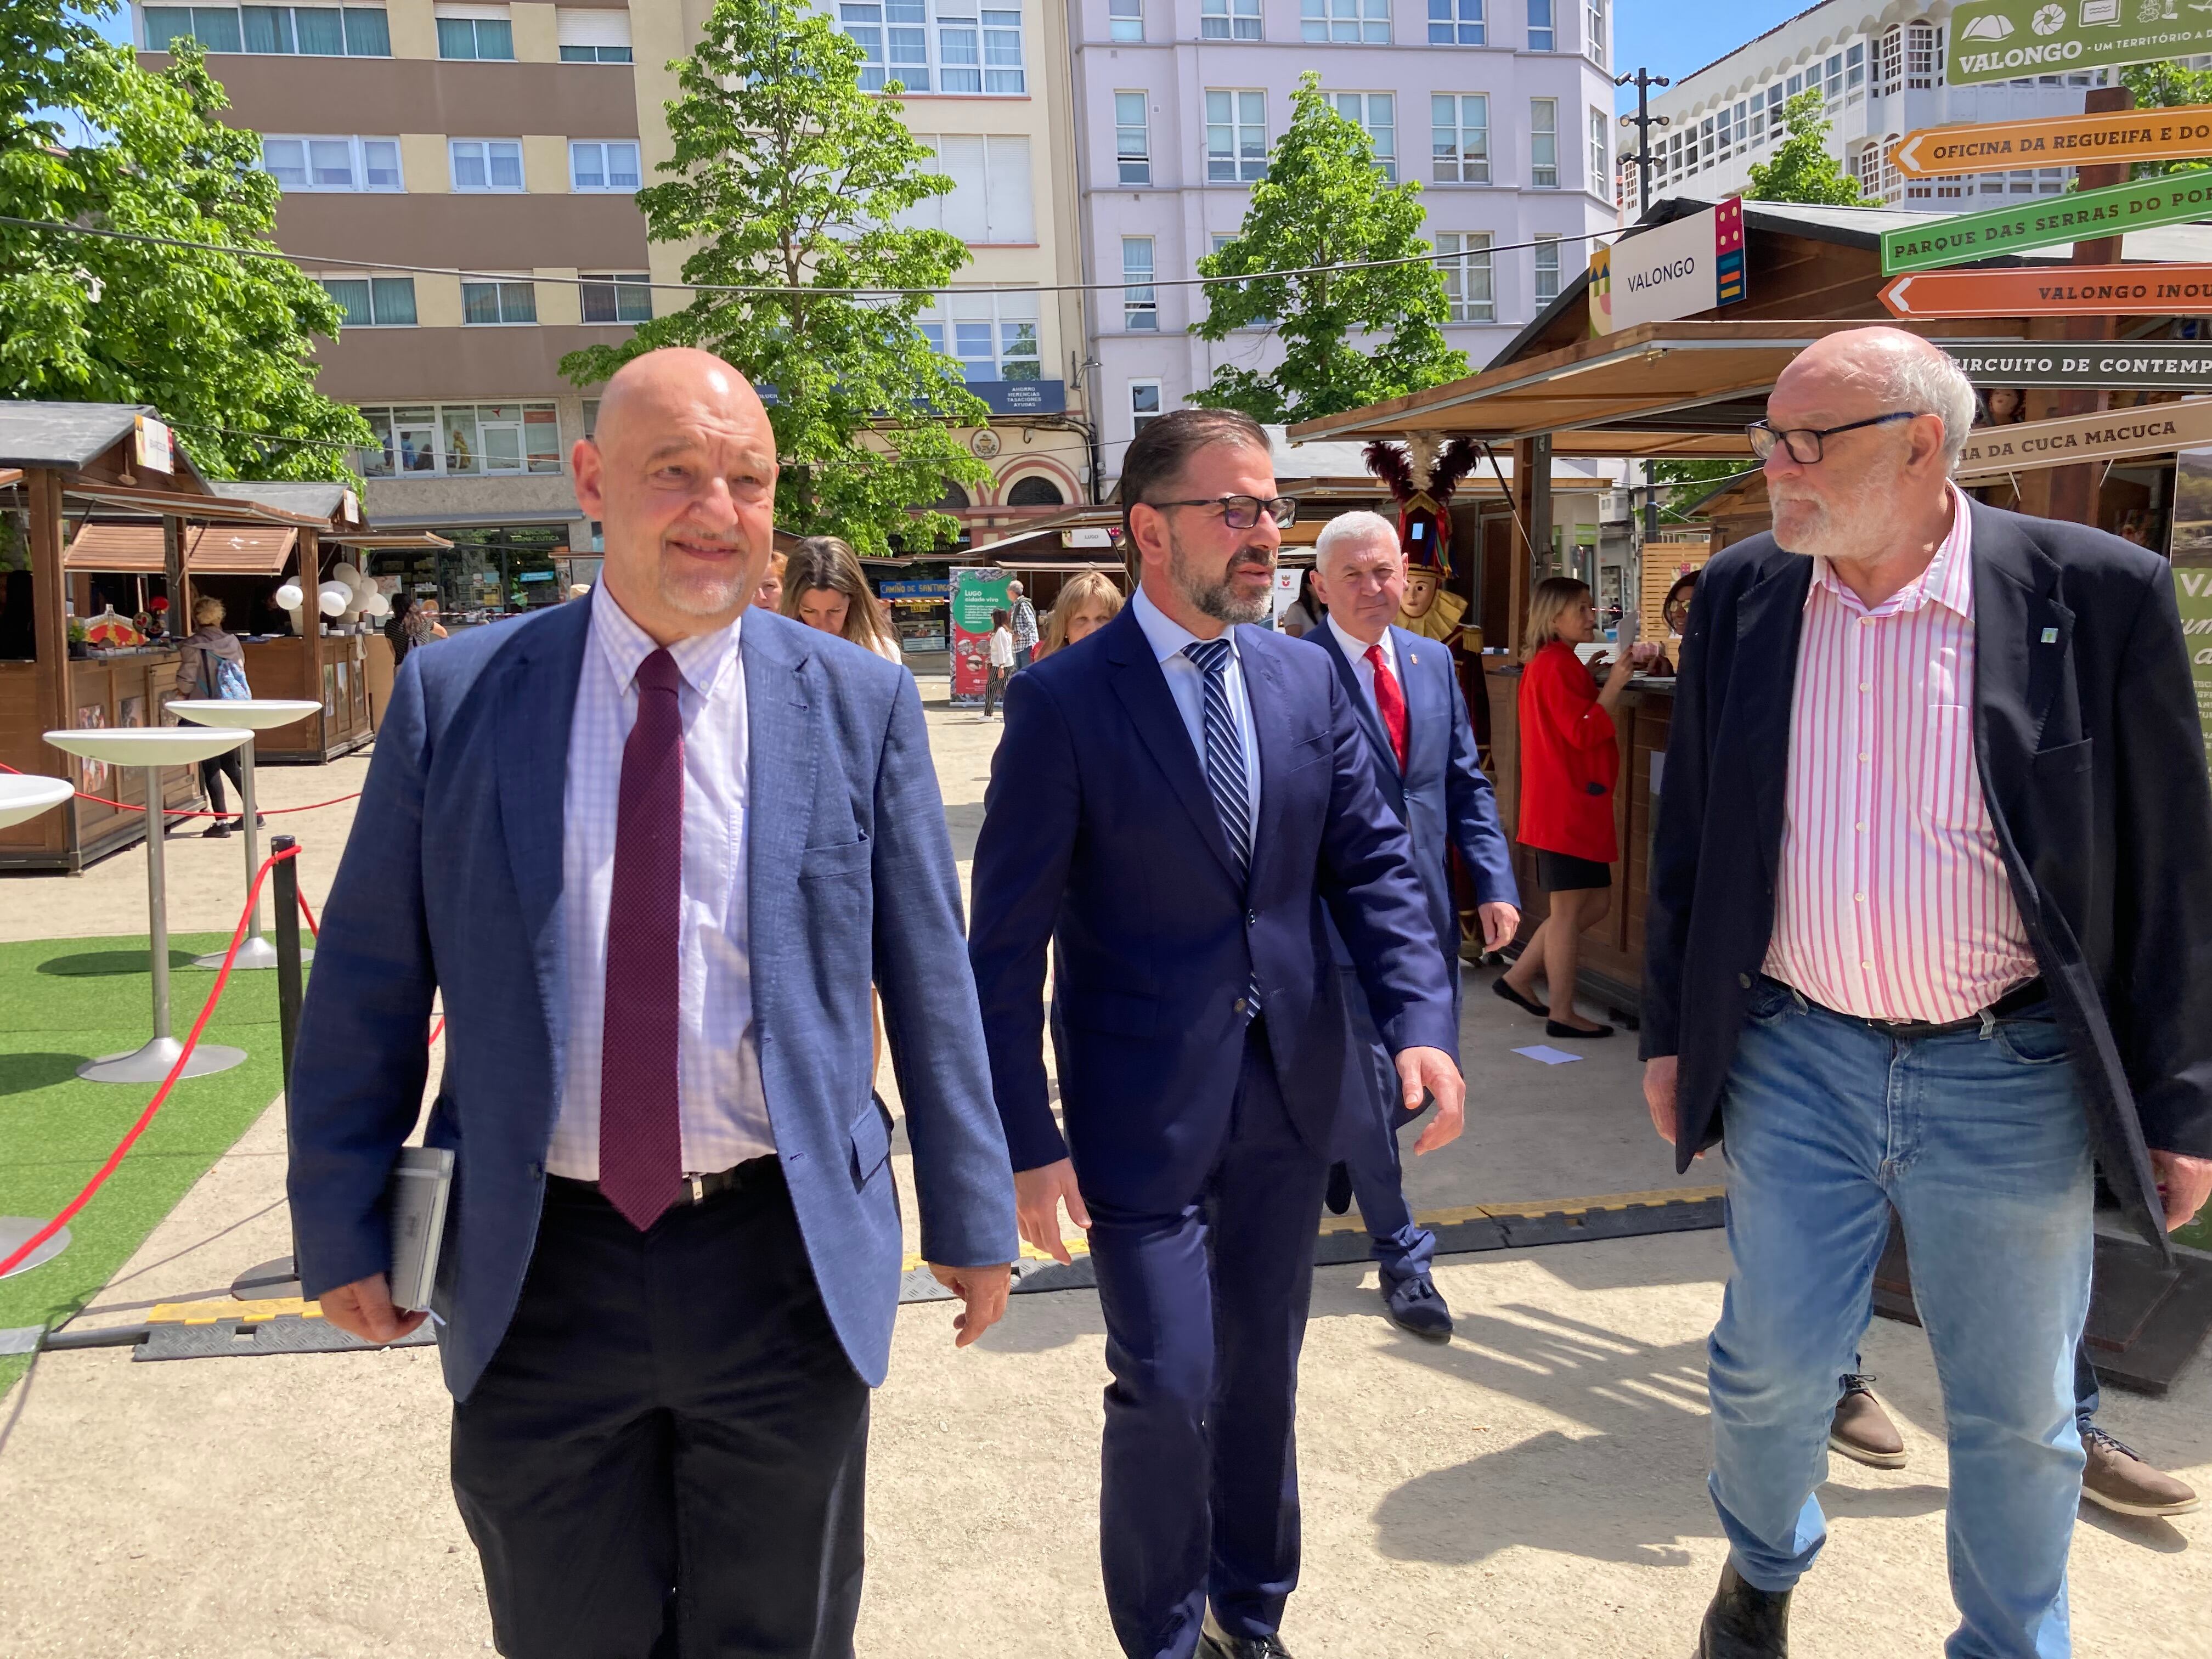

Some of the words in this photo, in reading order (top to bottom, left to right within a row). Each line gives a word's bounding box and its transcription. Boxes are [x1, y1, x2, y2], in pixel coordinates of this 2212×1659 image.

[1959, 41, 2083, 74] VALONGO
[2094, 42, 2112, 52] UM
[2117, 32, 2191, 49] TERRITÓRIO
[2194, 31, 2203, 40] A
[1933, 140, 2012, 159] OFICINA
[2019, 137, 2046, 152] DA
[2052, 129, 2153, 149] REGUEIFA
[2160, 127, 2172, 141] E
[2179, 125, 2210, 140] DO
[1894, 232, 1976, 258] PARQUE
[1985, 222, 2025, 241] DAS
[2035, 204, 2119, 231] SERRAS
[2129, 198, 2161, 214] DO
[1627, 257, 1695, 292] VALONGO
[2038, 285, 2147, 300] VALONGO
[2061, 358, 2090, 372] DE
[2100, 359, 2212, 374] CONTEMP
[1988, 443, 2015, 458] DA
[2022, 434, 2078, 453] CUCA
[2085, 421, 2176, 444] MACUCA
[919, 584, 950, 592] SANTIAGO
